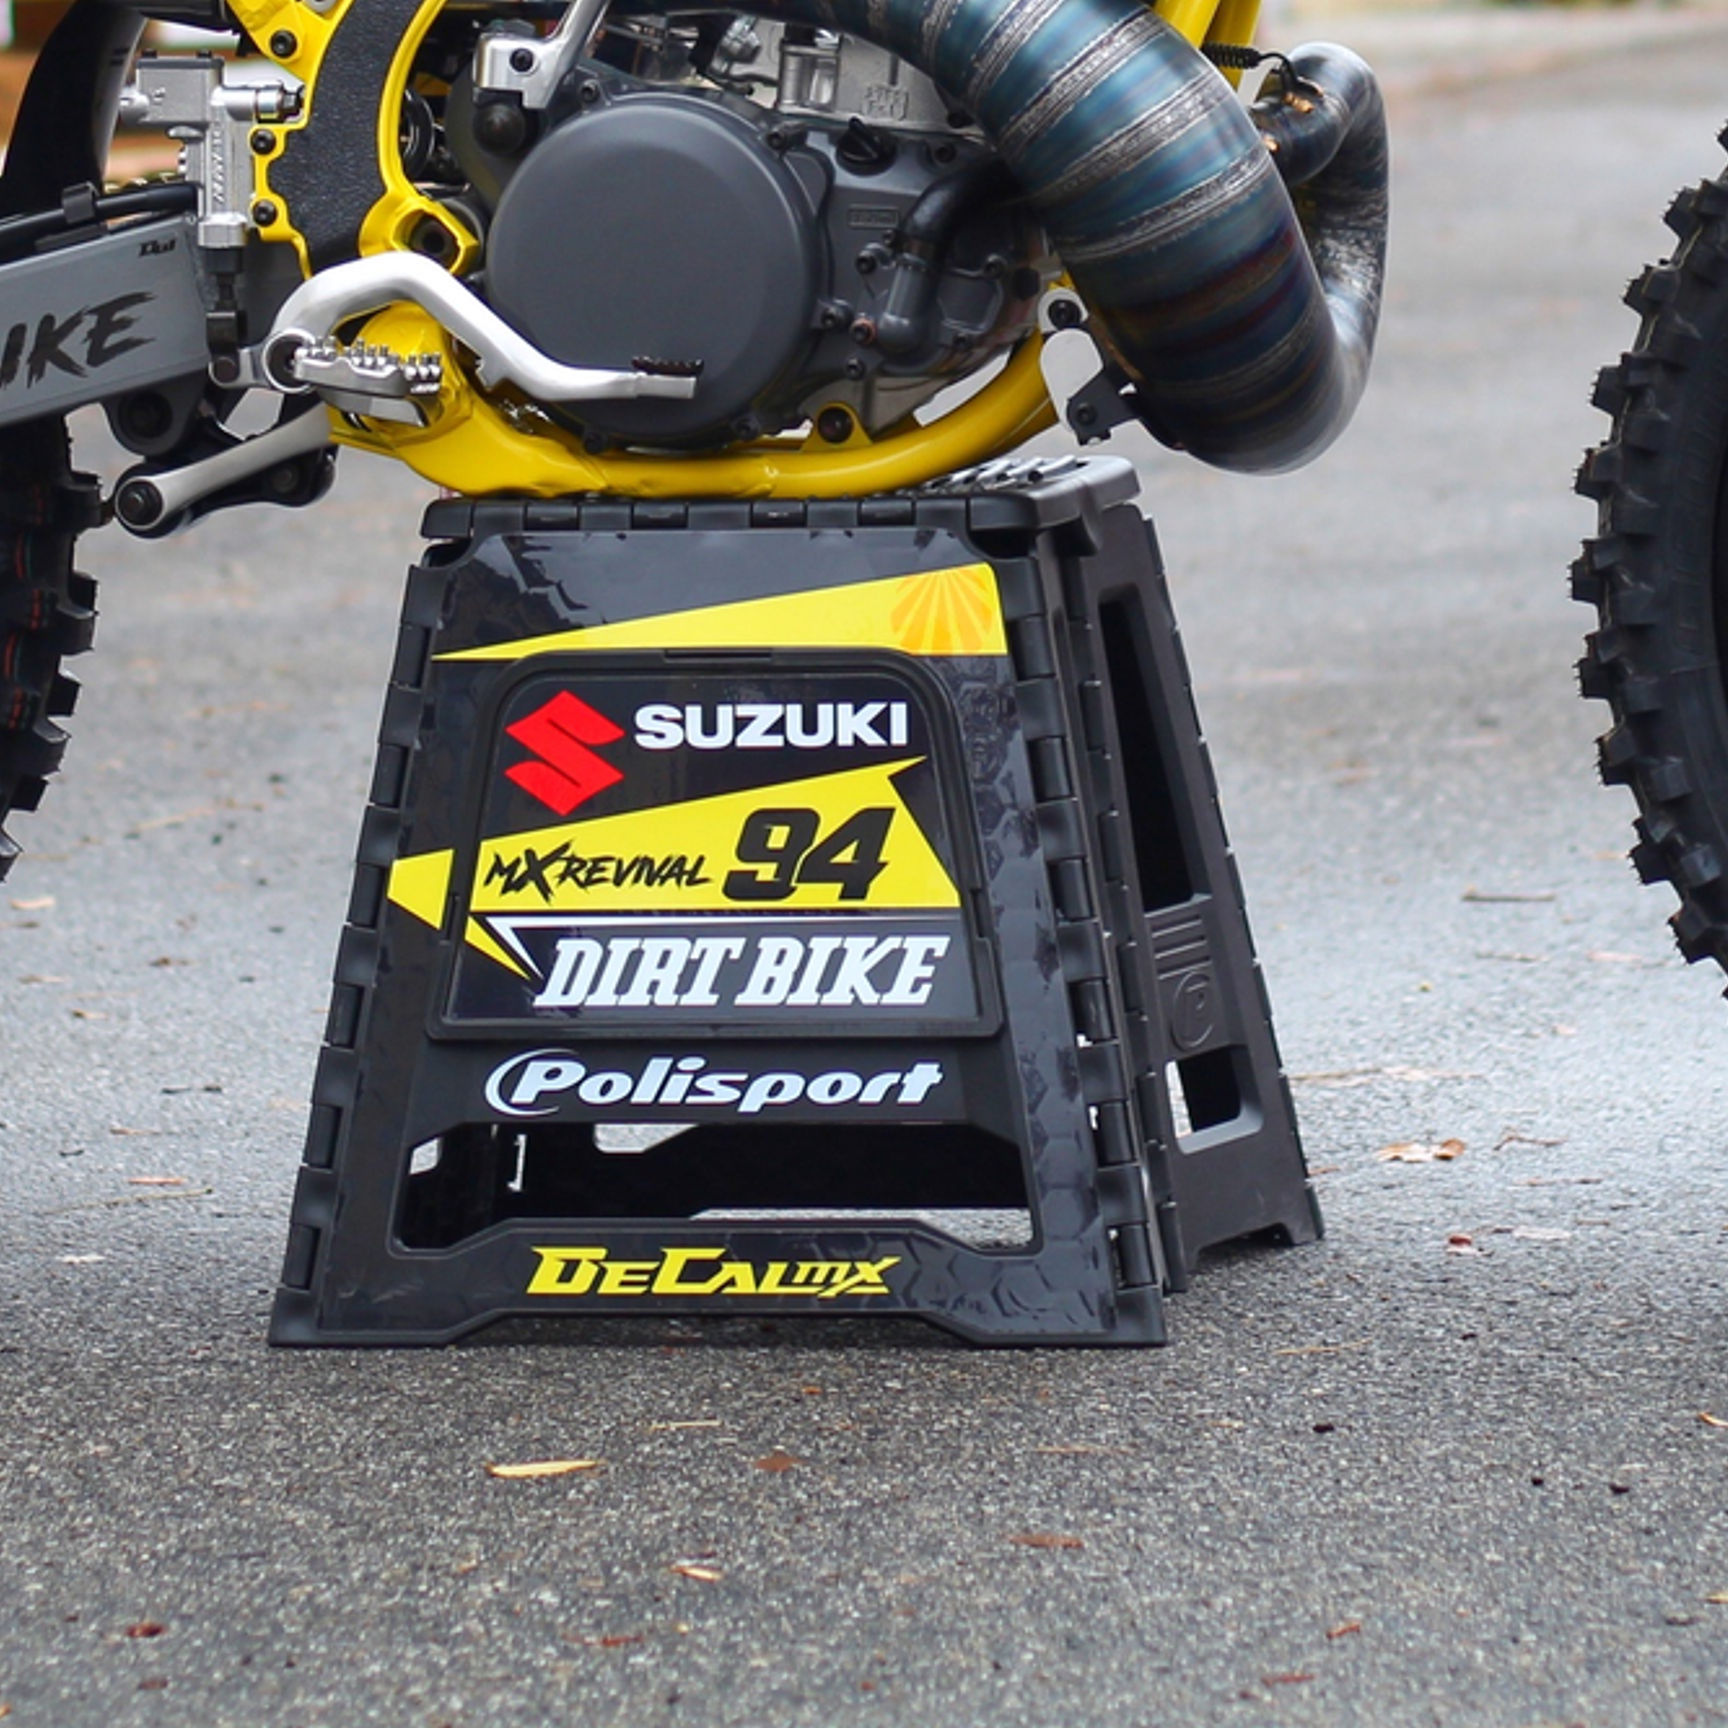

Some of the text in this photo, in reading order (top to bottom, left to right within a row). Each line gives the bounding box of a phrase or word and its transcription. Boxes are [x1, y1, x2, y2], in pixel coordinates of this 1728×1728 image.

[634, 702, 908, 749] SUZUKI
[483, 838, 714, 905] MX REVIVAL
[722, 807, 897, 903] 94
[532, 937, 950, 1007] DIRT BIKE
[508, 1055, 944, 1113] Polisport
